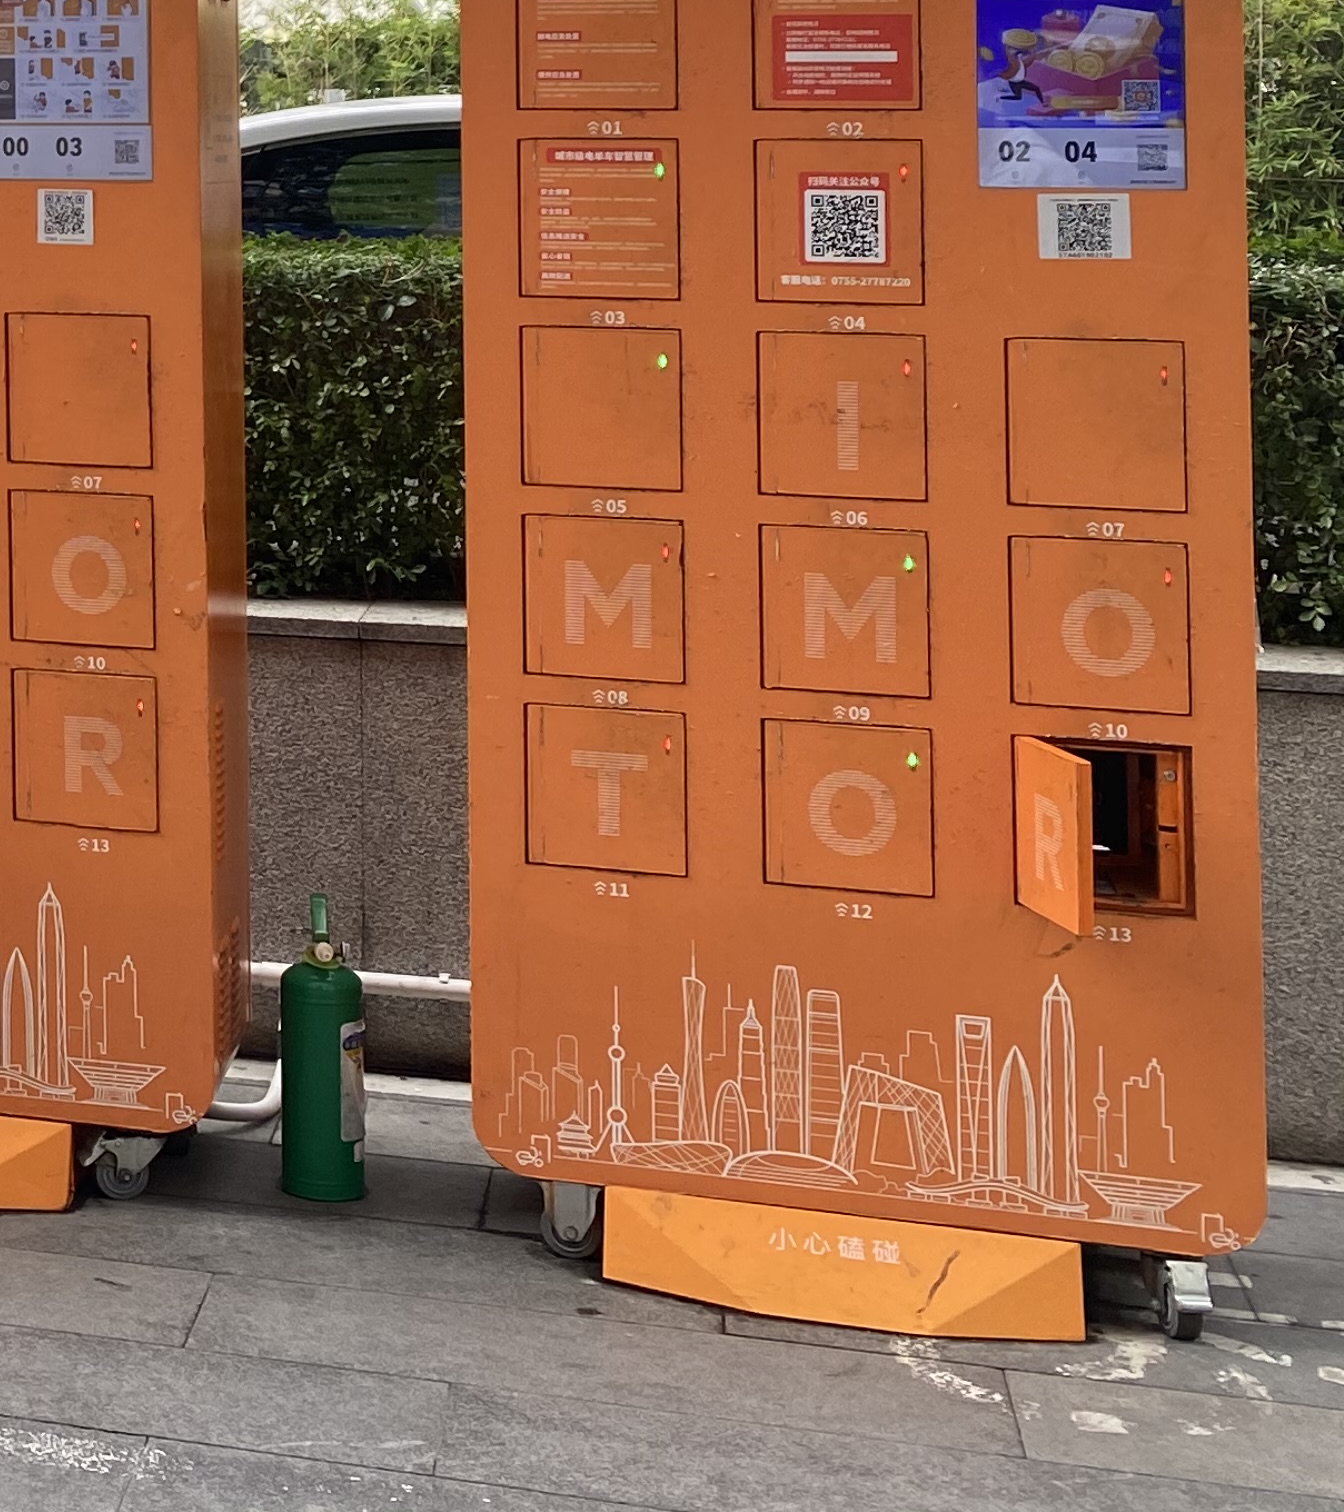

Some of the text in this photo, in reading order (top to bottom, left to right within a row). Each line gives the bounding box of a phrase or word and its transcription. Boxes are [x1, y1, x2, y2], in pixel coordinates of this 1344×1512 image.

[601, 120, 623, 136] 01
[841, 121, 864, 137] 02
[2, 137, 82, 157] 00 03
[998, 140, 1098, 163] 02 04
[807, 175, 880, 188] 扫码关注公众号
[604, 310, 626, 325] 03
[843, 315, 866, 331] 04
[83, 475, 103, 490] 07
[605, 498, 629, 515] 05
[845, 509, 869, 527] 06
[1102, 521, 1126, 539] 07
[51, 535, 127, 615] O
[563, 560, 1156, 677] M M O
[87, 656, 106, 671] 10
[606, 689, 630, 706] 08
[848, 704, 872, 722] 09
[1105, 722, 1129, 741] 10
[63, 715, 124, 796] R
[570, 750, 1065, 892] T O R
[91, 839, 110, 854] 13
[608, 882, 630, 899] 11
[851, 902, 874, 920] 12
[1110, 926, 1133, 944] 13
[768, 1225, 901, 1267] 小心磕碰
